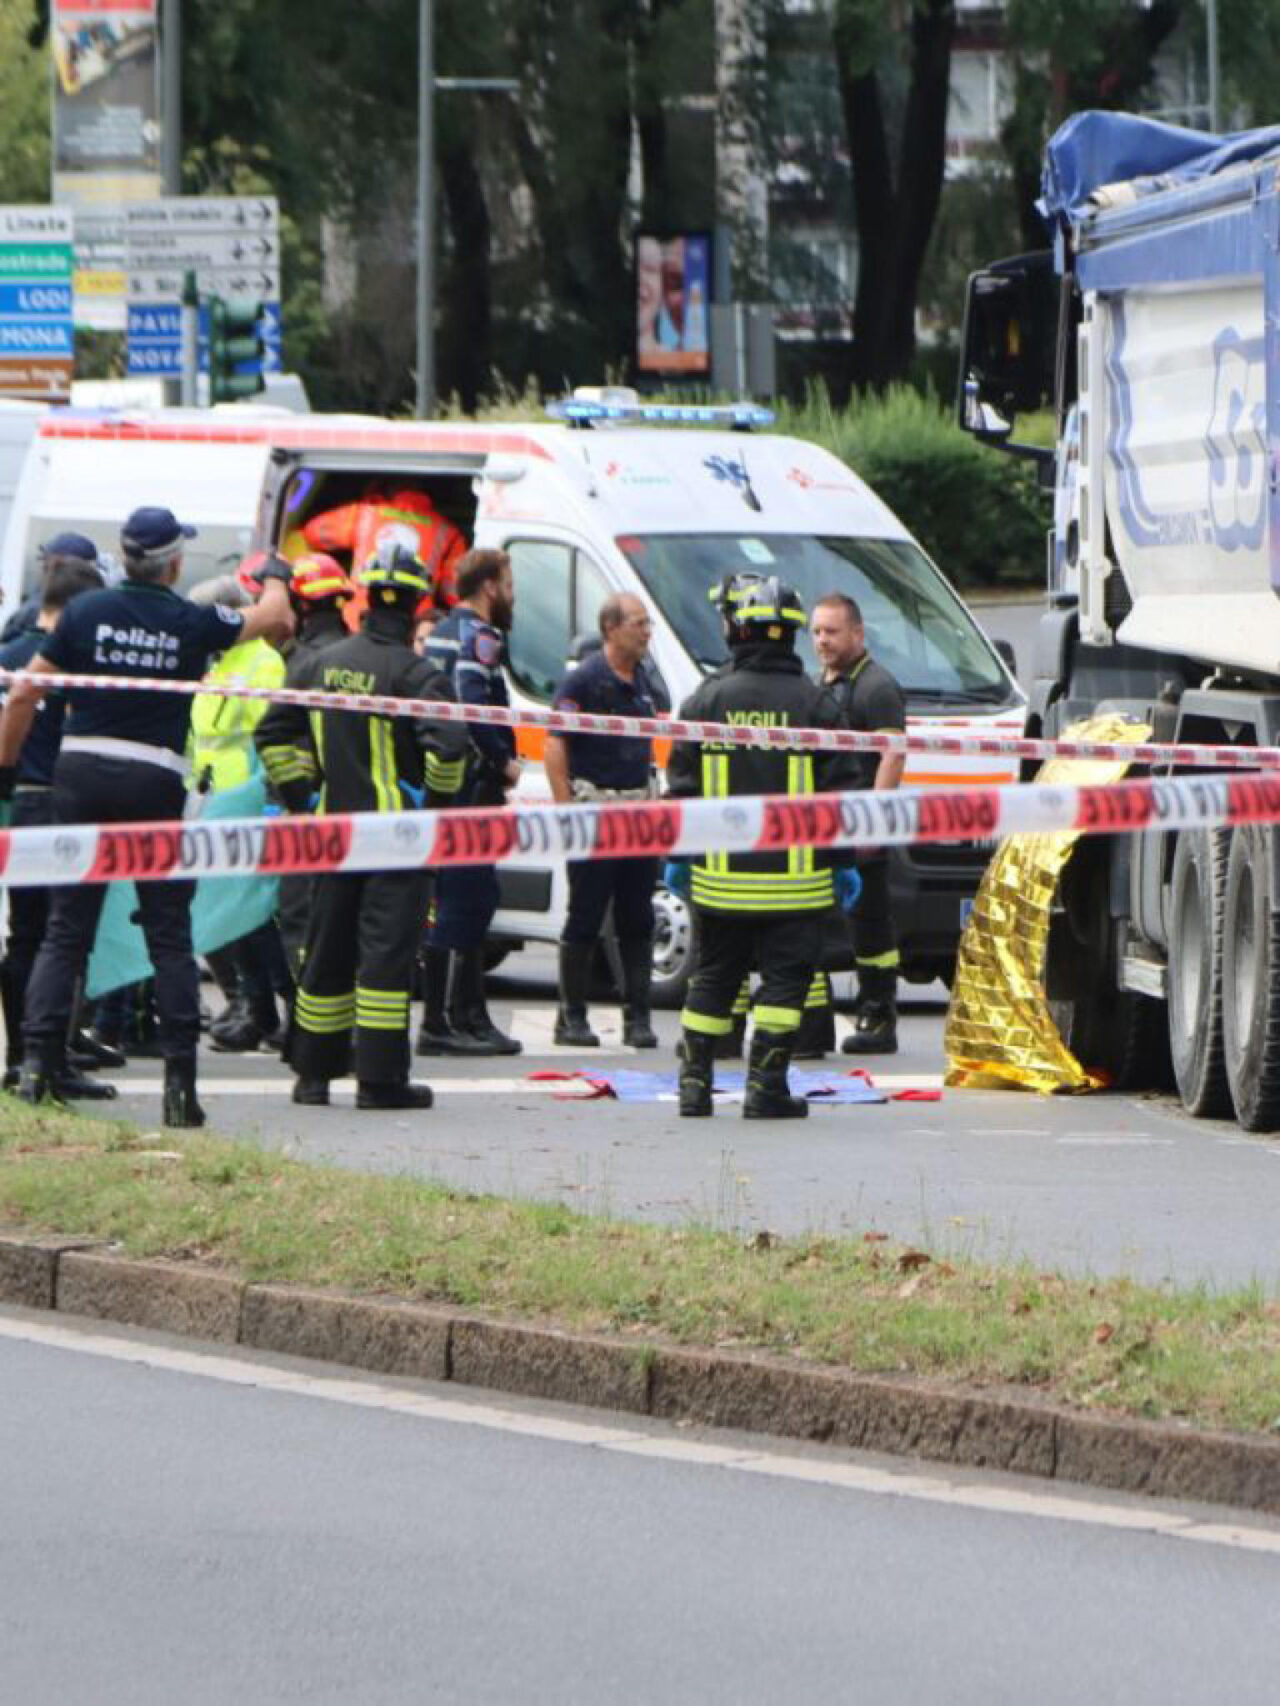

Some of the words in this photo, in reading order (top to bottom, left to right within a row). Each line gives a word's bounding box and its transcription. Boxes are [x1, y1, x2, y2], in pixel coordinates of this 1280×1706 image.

[18, 288, 70, 311] LODI
[96, 623, 181, 650] Polizia
[95, 645, 180, 670] Locale
[324, 667, 376, 692] VIGILI
[726, 710, 791, 728] VIGILI
[438, 812, 549, 856] LOCALE
[553, 808, 675, 850] POLIZIA
[765, 799, 873, 842] LOCALE
[881, 794, 995, 834] POLIZIA
[101, 827, 213, 873] LOCALE
[220, 822, 342, 867] POLIZIA
